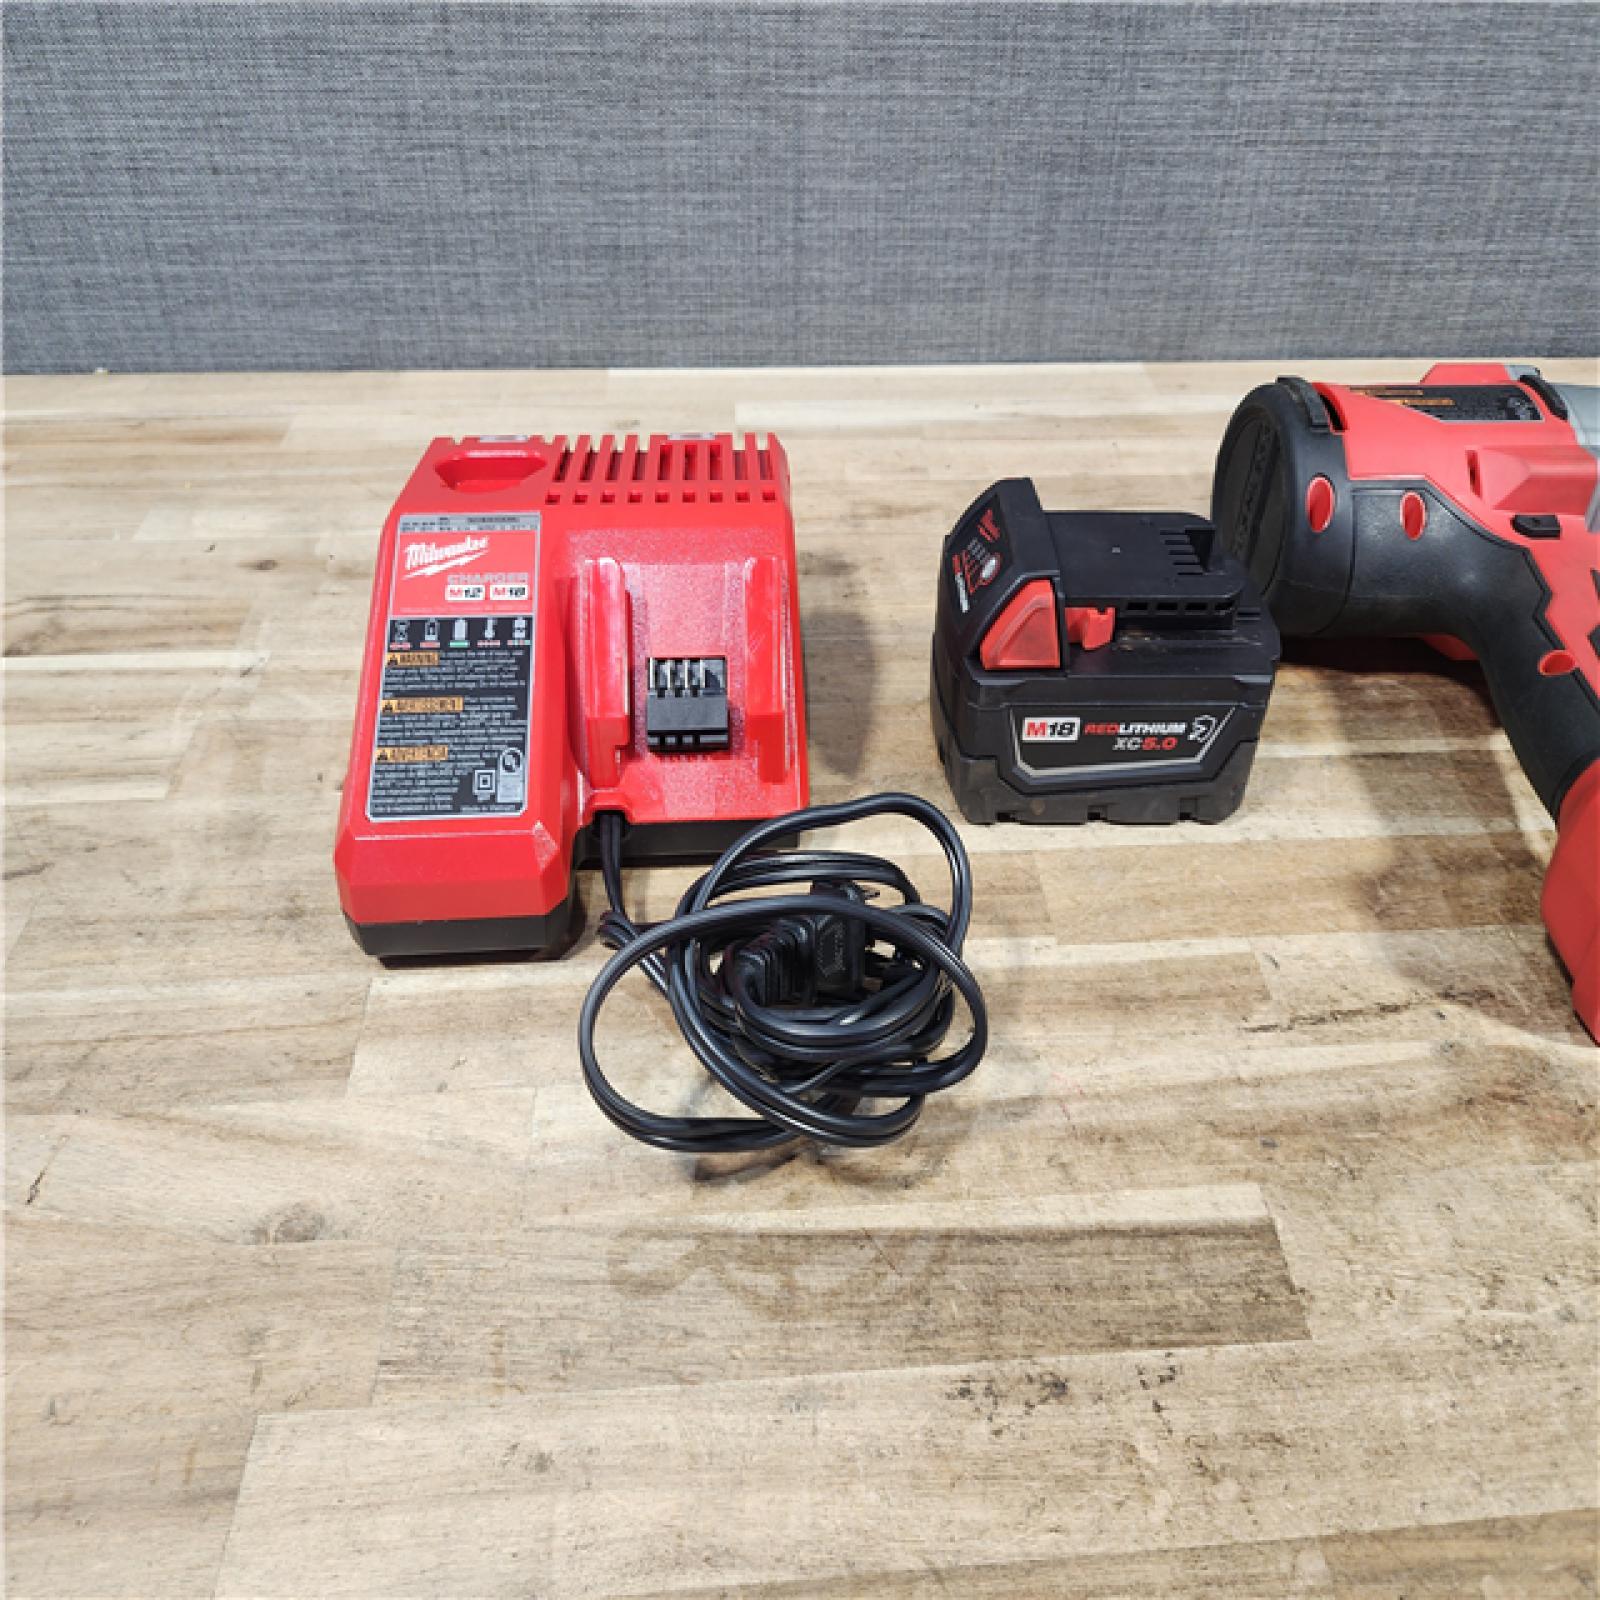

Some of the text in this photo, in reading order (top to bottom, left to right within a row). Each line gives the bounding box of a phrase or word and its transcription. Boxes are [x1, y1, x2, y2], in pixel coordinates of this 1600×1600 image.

[403, 535, 489, 570] Milwaukee
[1026, 721, 1187, 737] M18 REDLITHIUM
[1112, 737, 1178, 750] XC5.0
